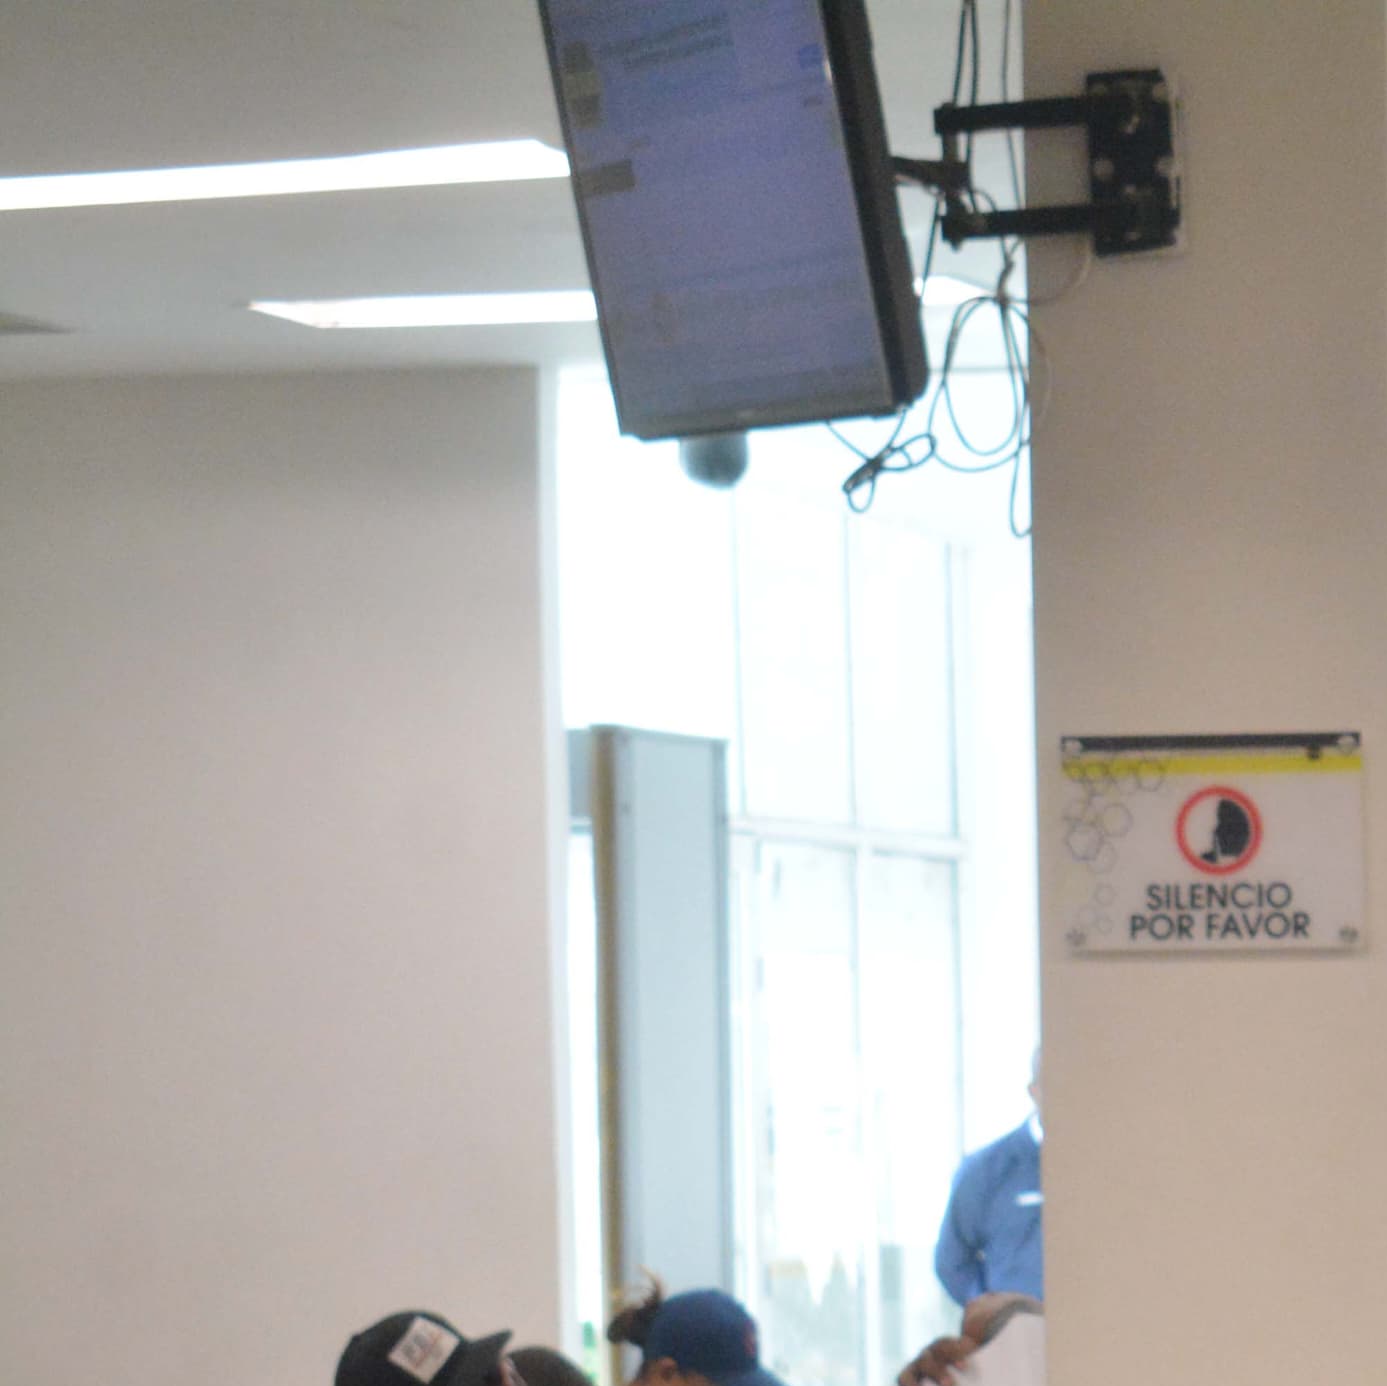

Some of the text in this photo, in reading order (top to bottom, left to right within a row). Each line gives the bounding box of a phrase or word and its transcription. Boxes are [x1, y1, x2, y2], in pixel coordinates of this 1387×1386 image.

[1147, 882, 1291, 910] SILENCIO
[1130, 912, 1310, 940] POR FAVOR
